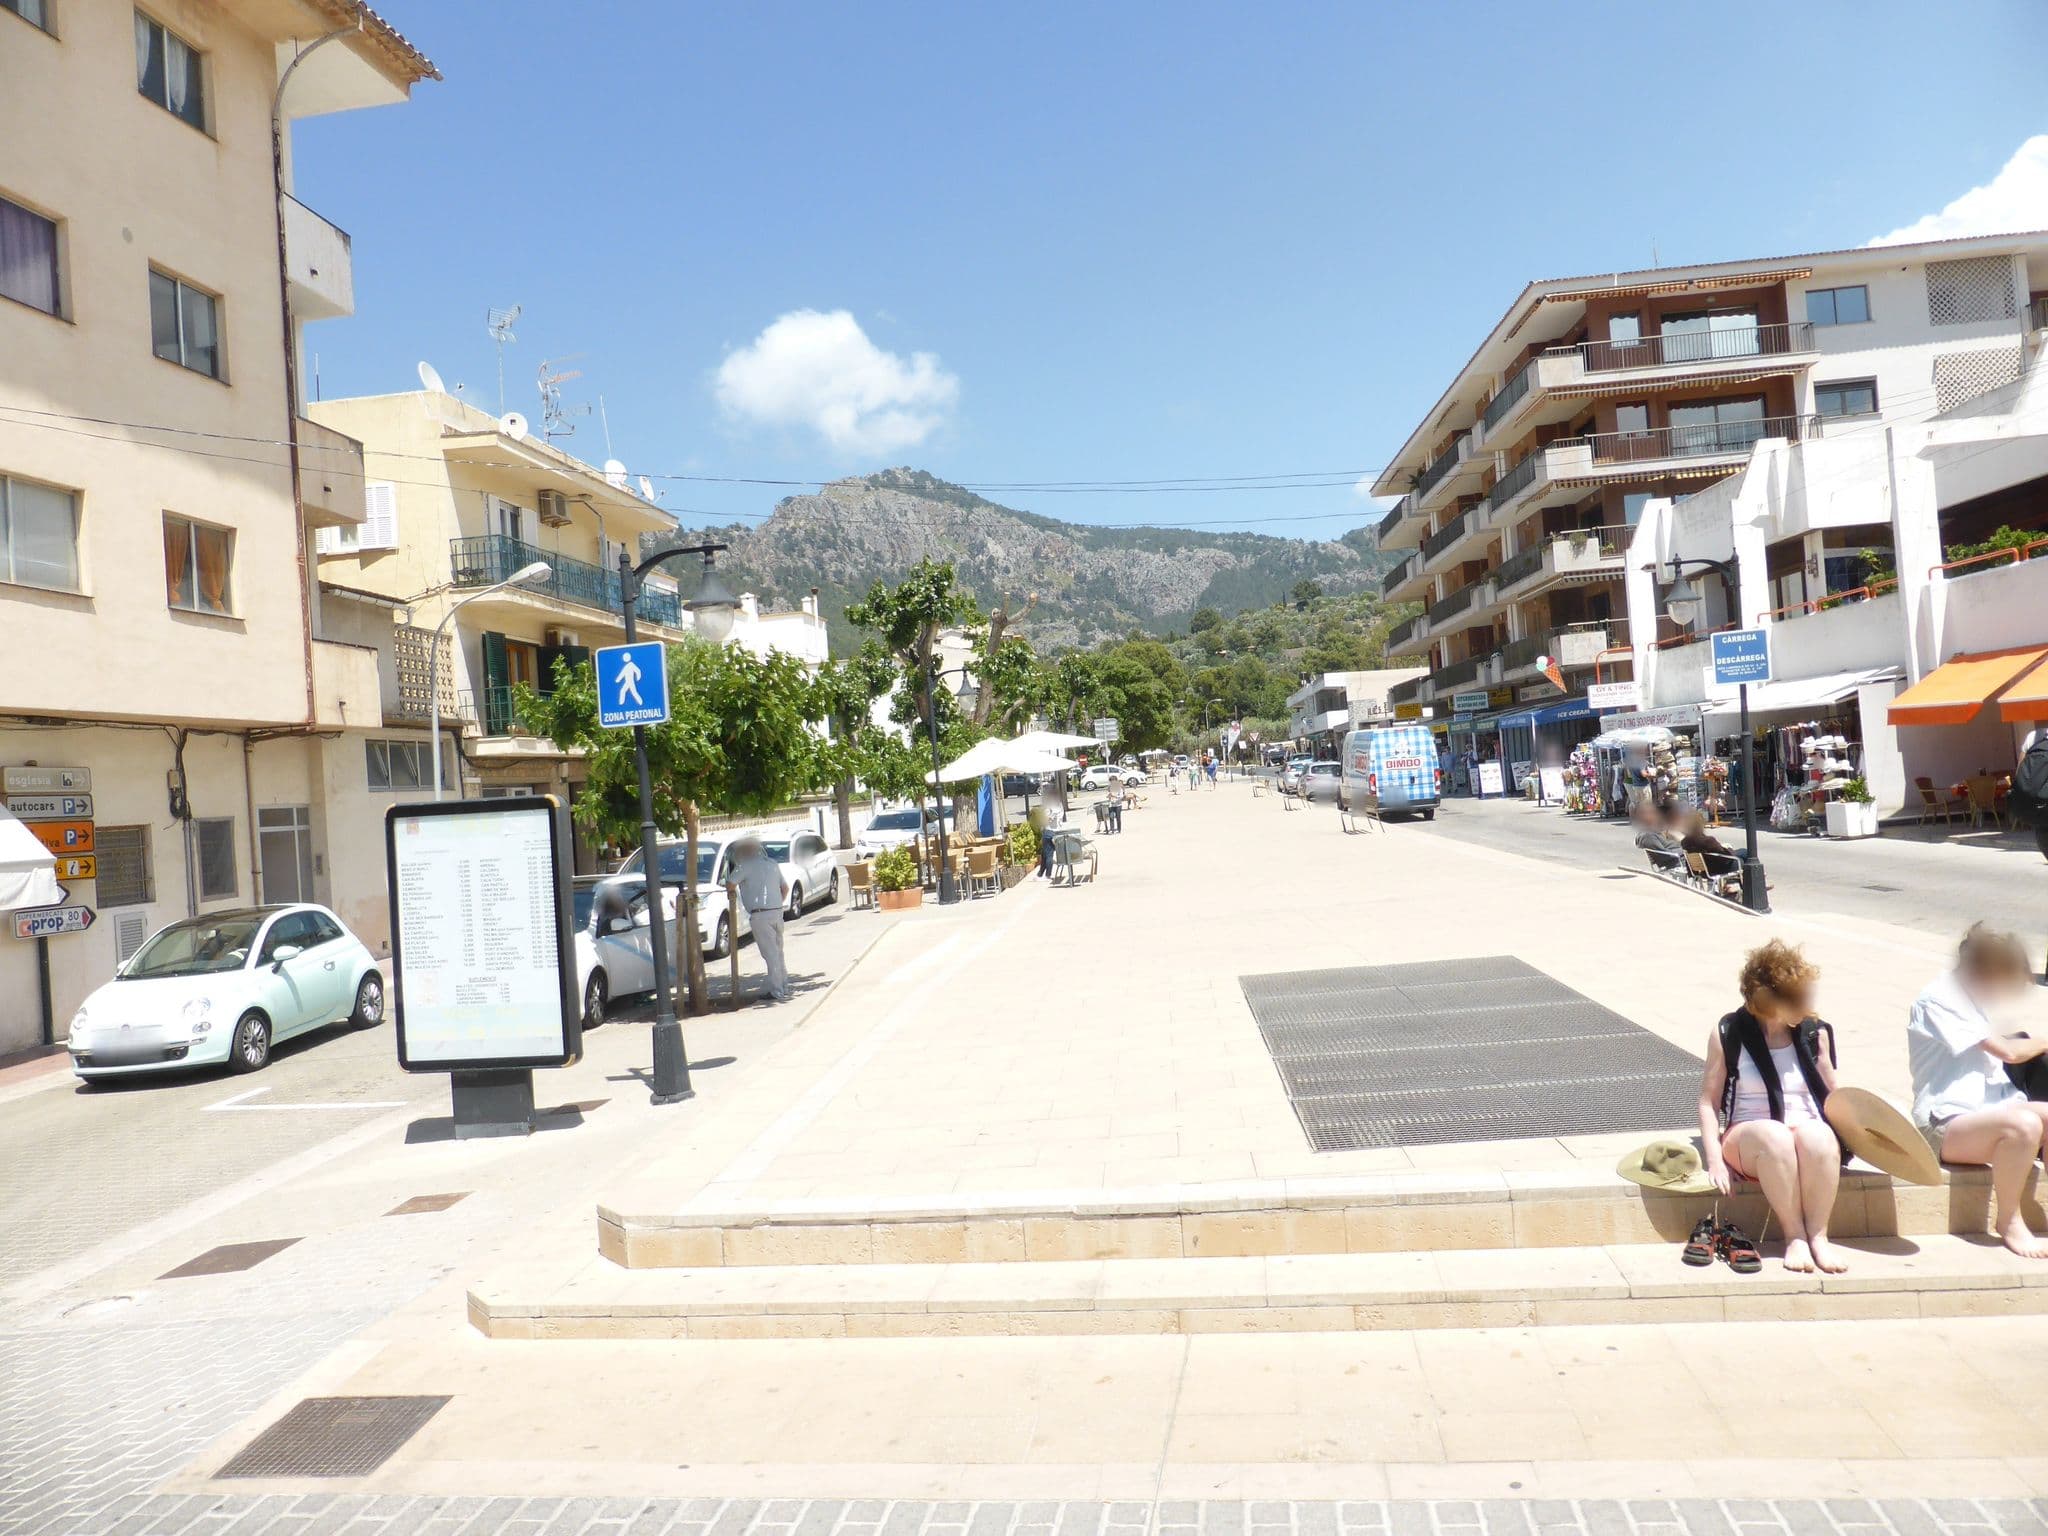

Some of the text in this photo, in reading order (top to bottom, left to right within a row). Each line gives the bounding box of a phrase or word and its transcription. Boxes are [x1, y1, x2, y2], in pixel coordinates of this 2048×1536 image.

[603, 708, 663, 722] ZONA PEATONAL
[1568, 709, 1590, 717] CREAM
[1385, 758, 1421, 769] BIMBO
[11, 801, 55, 812] autocars
[68, 910, 79, 921] 80
